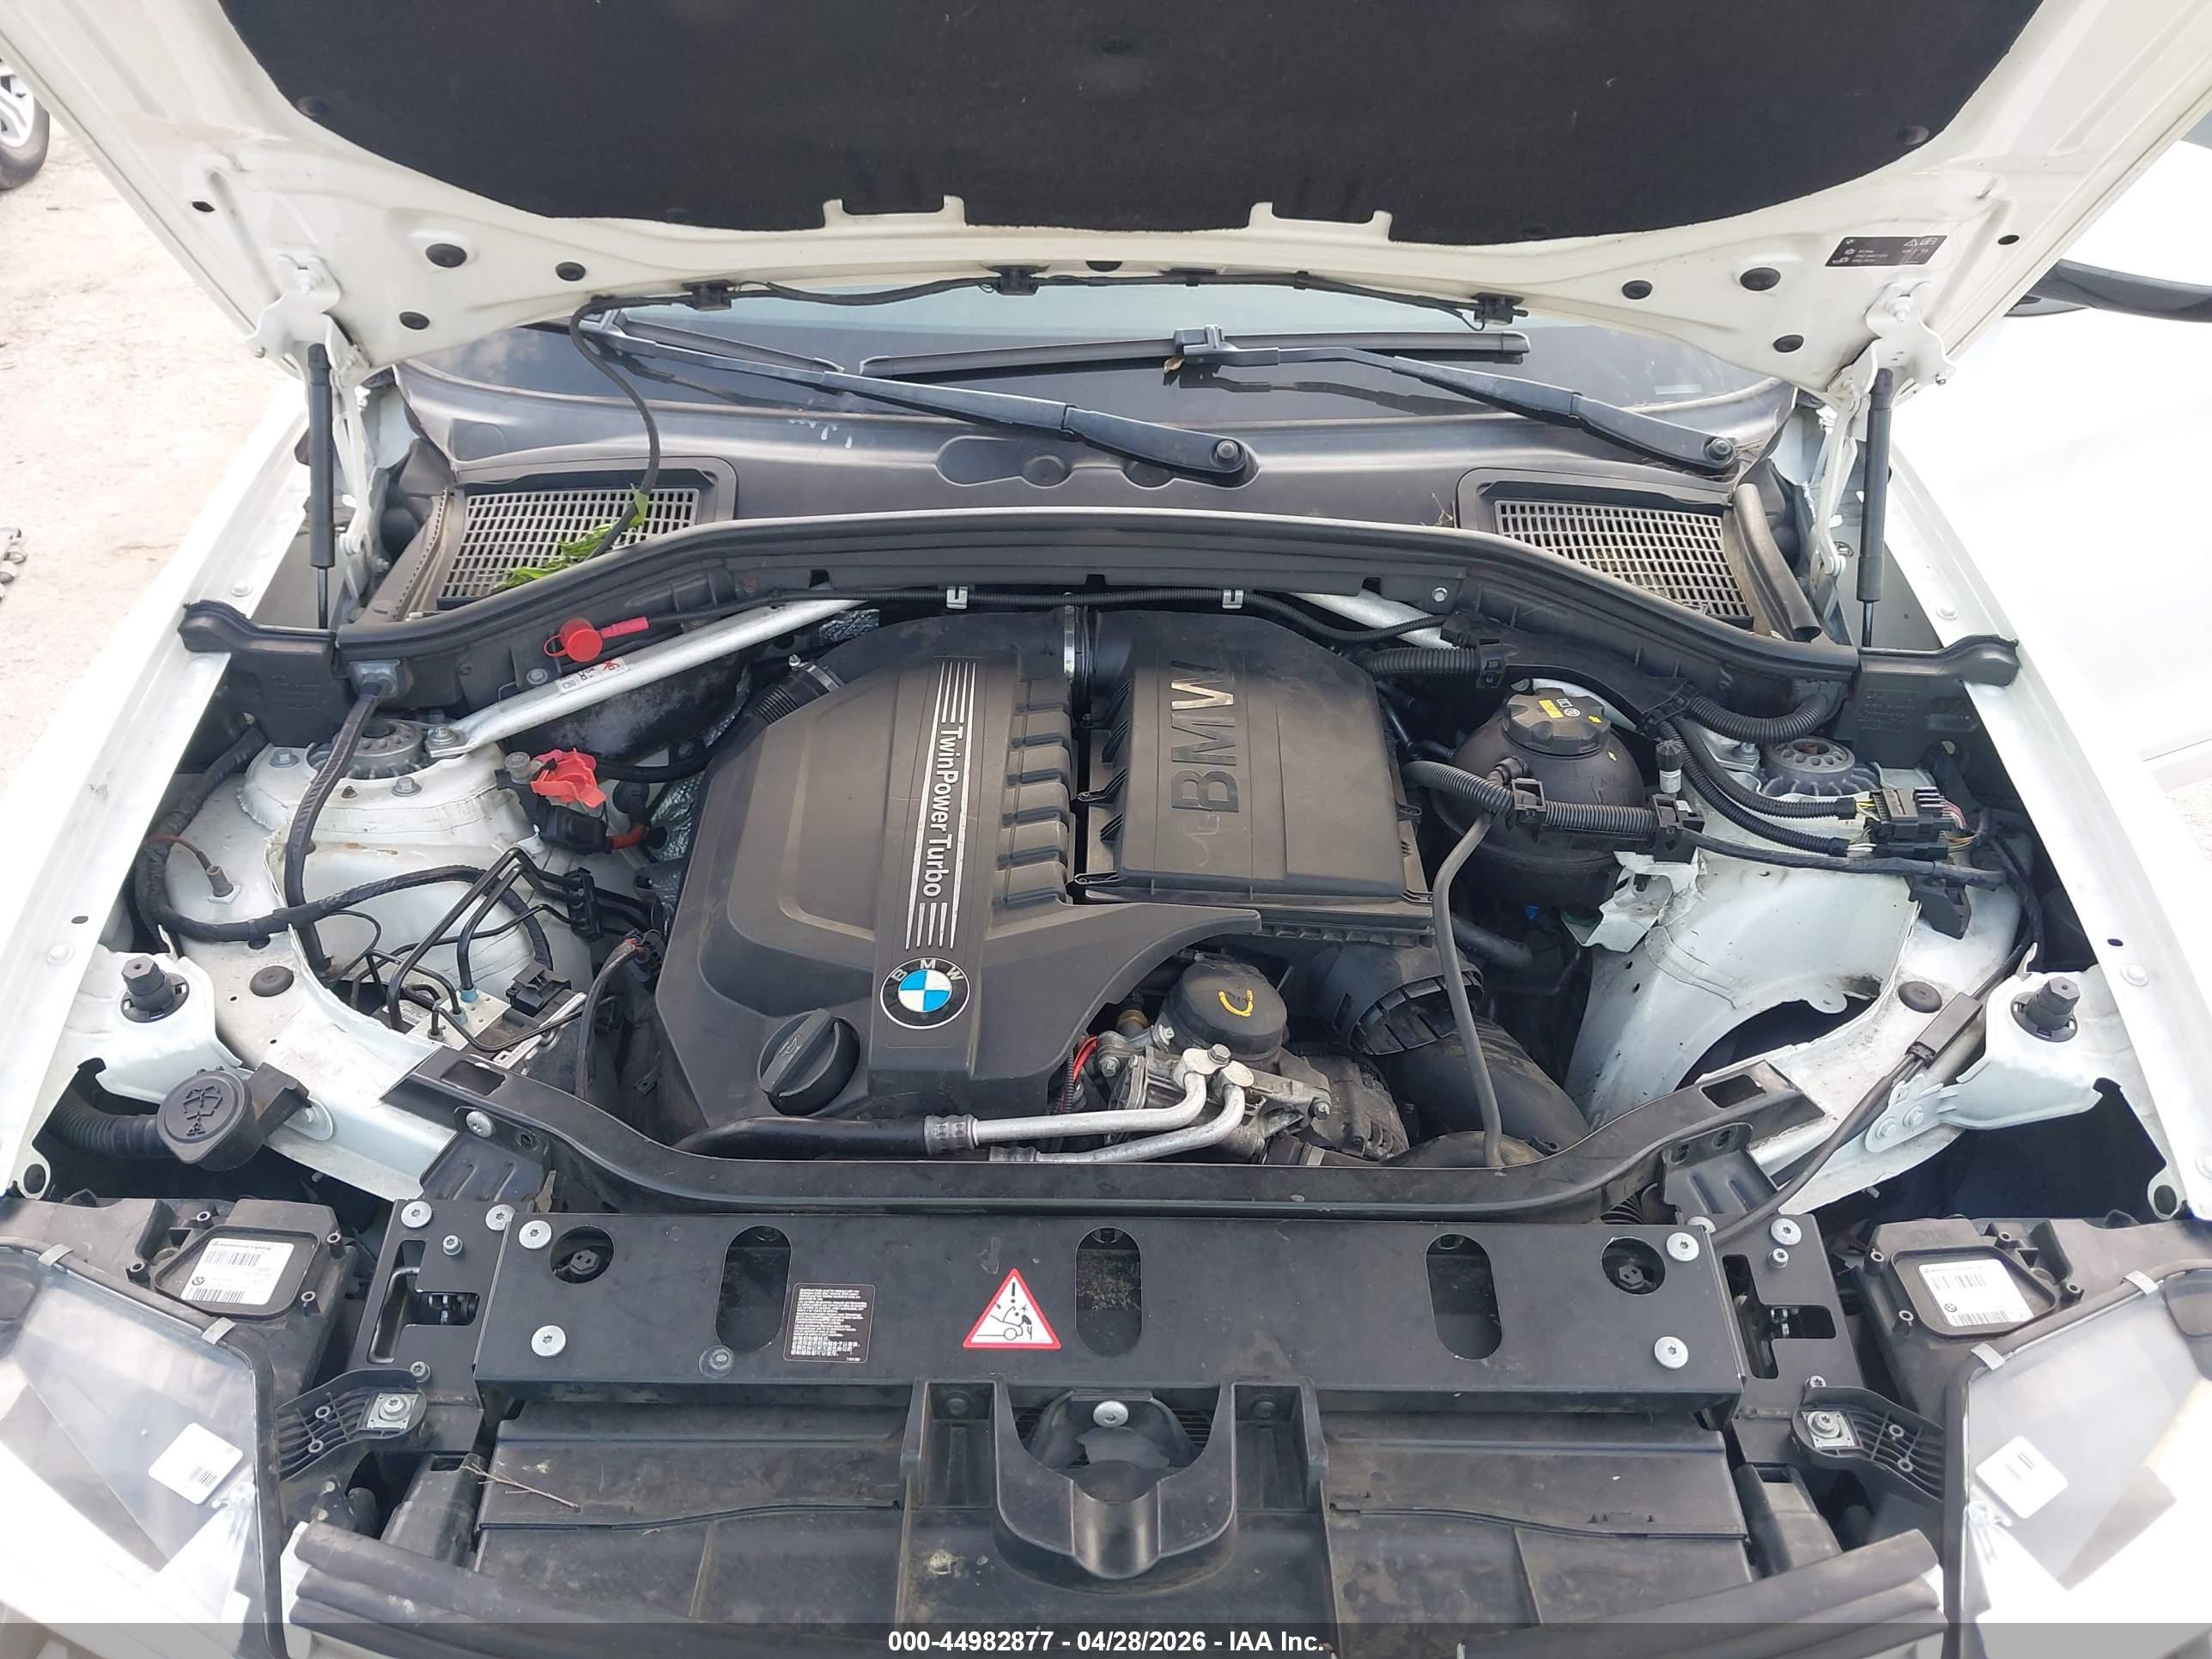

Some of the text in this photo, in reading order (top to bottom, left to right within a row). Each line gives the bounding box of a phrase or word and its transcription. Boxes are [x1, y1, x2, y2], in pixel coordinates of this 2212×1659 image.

[922, 726, 964, 897] TwinPower Turbo
[1170, 659, 1239, 813] BMW
[890, 959, 964, 982] BMW
